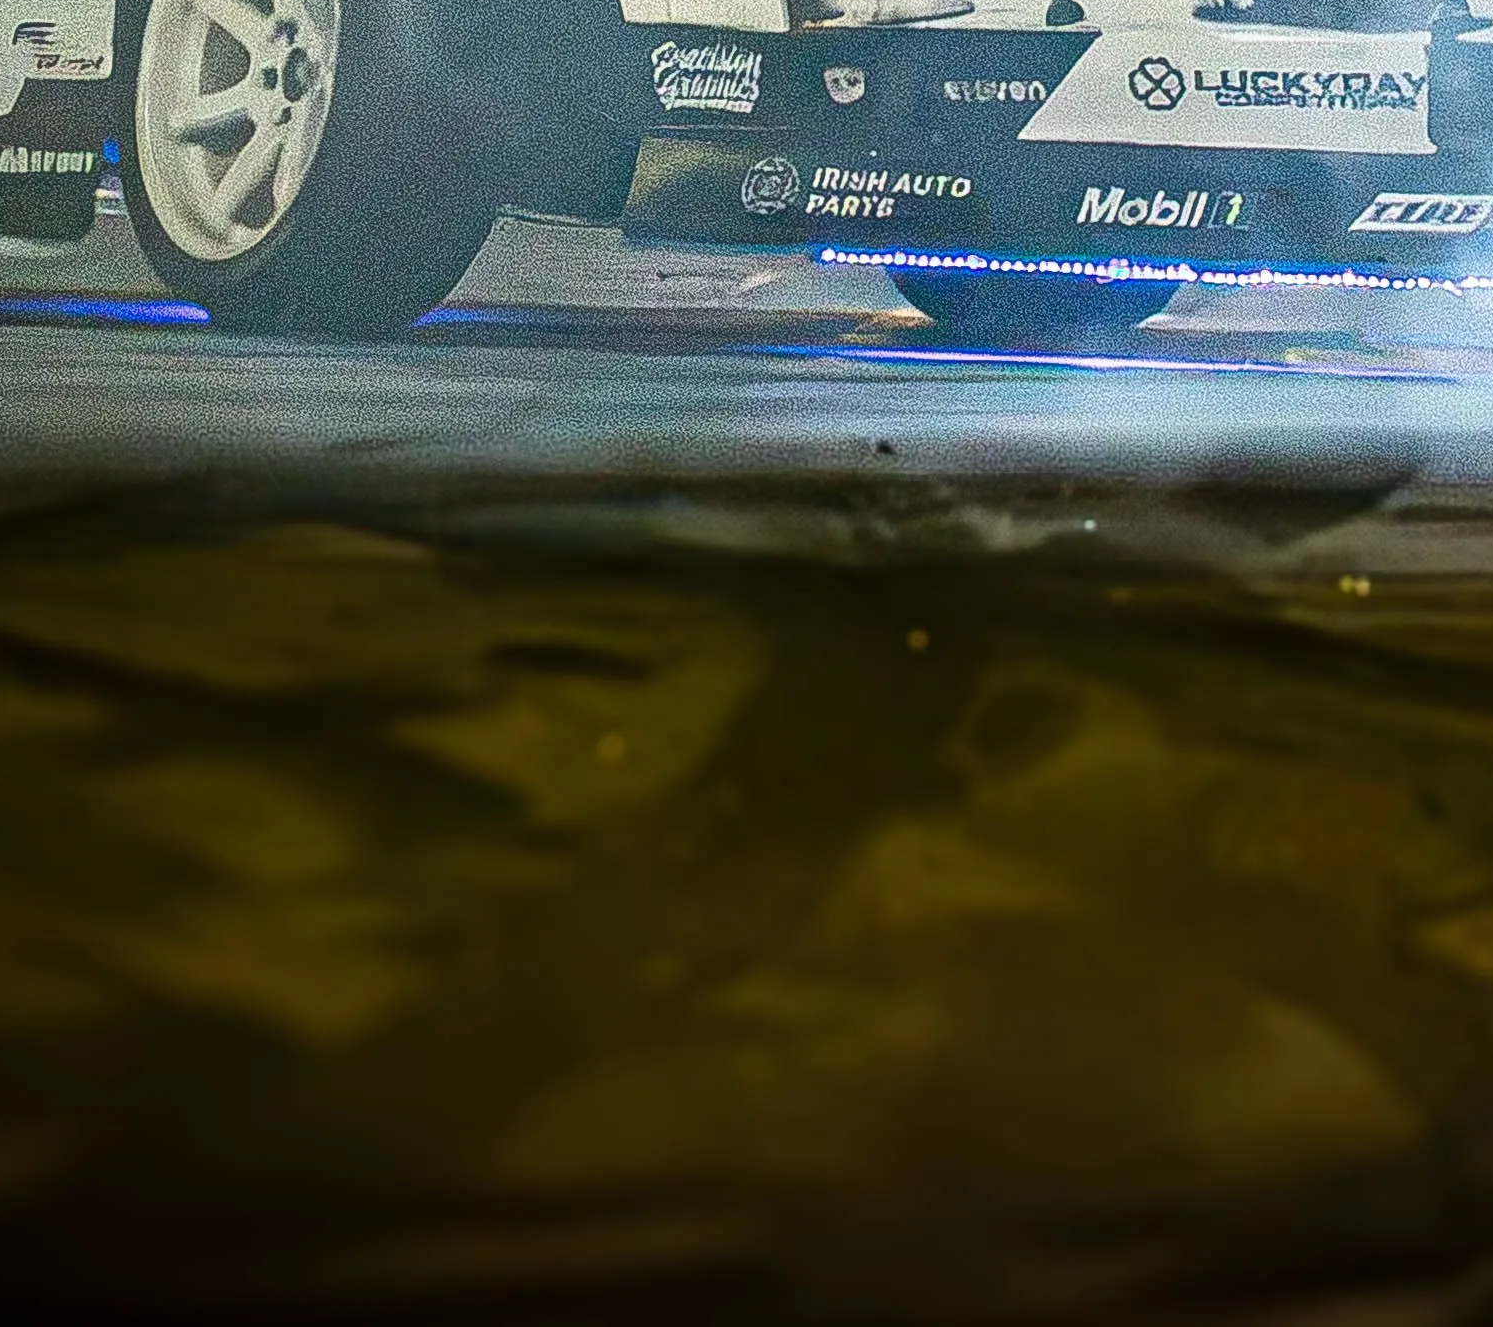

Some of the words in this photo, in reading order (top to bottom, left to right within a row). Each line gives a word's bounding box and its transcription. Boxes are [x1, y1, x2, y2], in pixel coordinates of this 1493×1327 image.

[1194, 69, 1427, 96] LUCKYDAY
[812, 167, 888, 192] IRISH
[891, 173, 972, 197] AUTO
[805, 195, 895, 218] PARTS
[1076, 186, 1209, 228] Mobil
